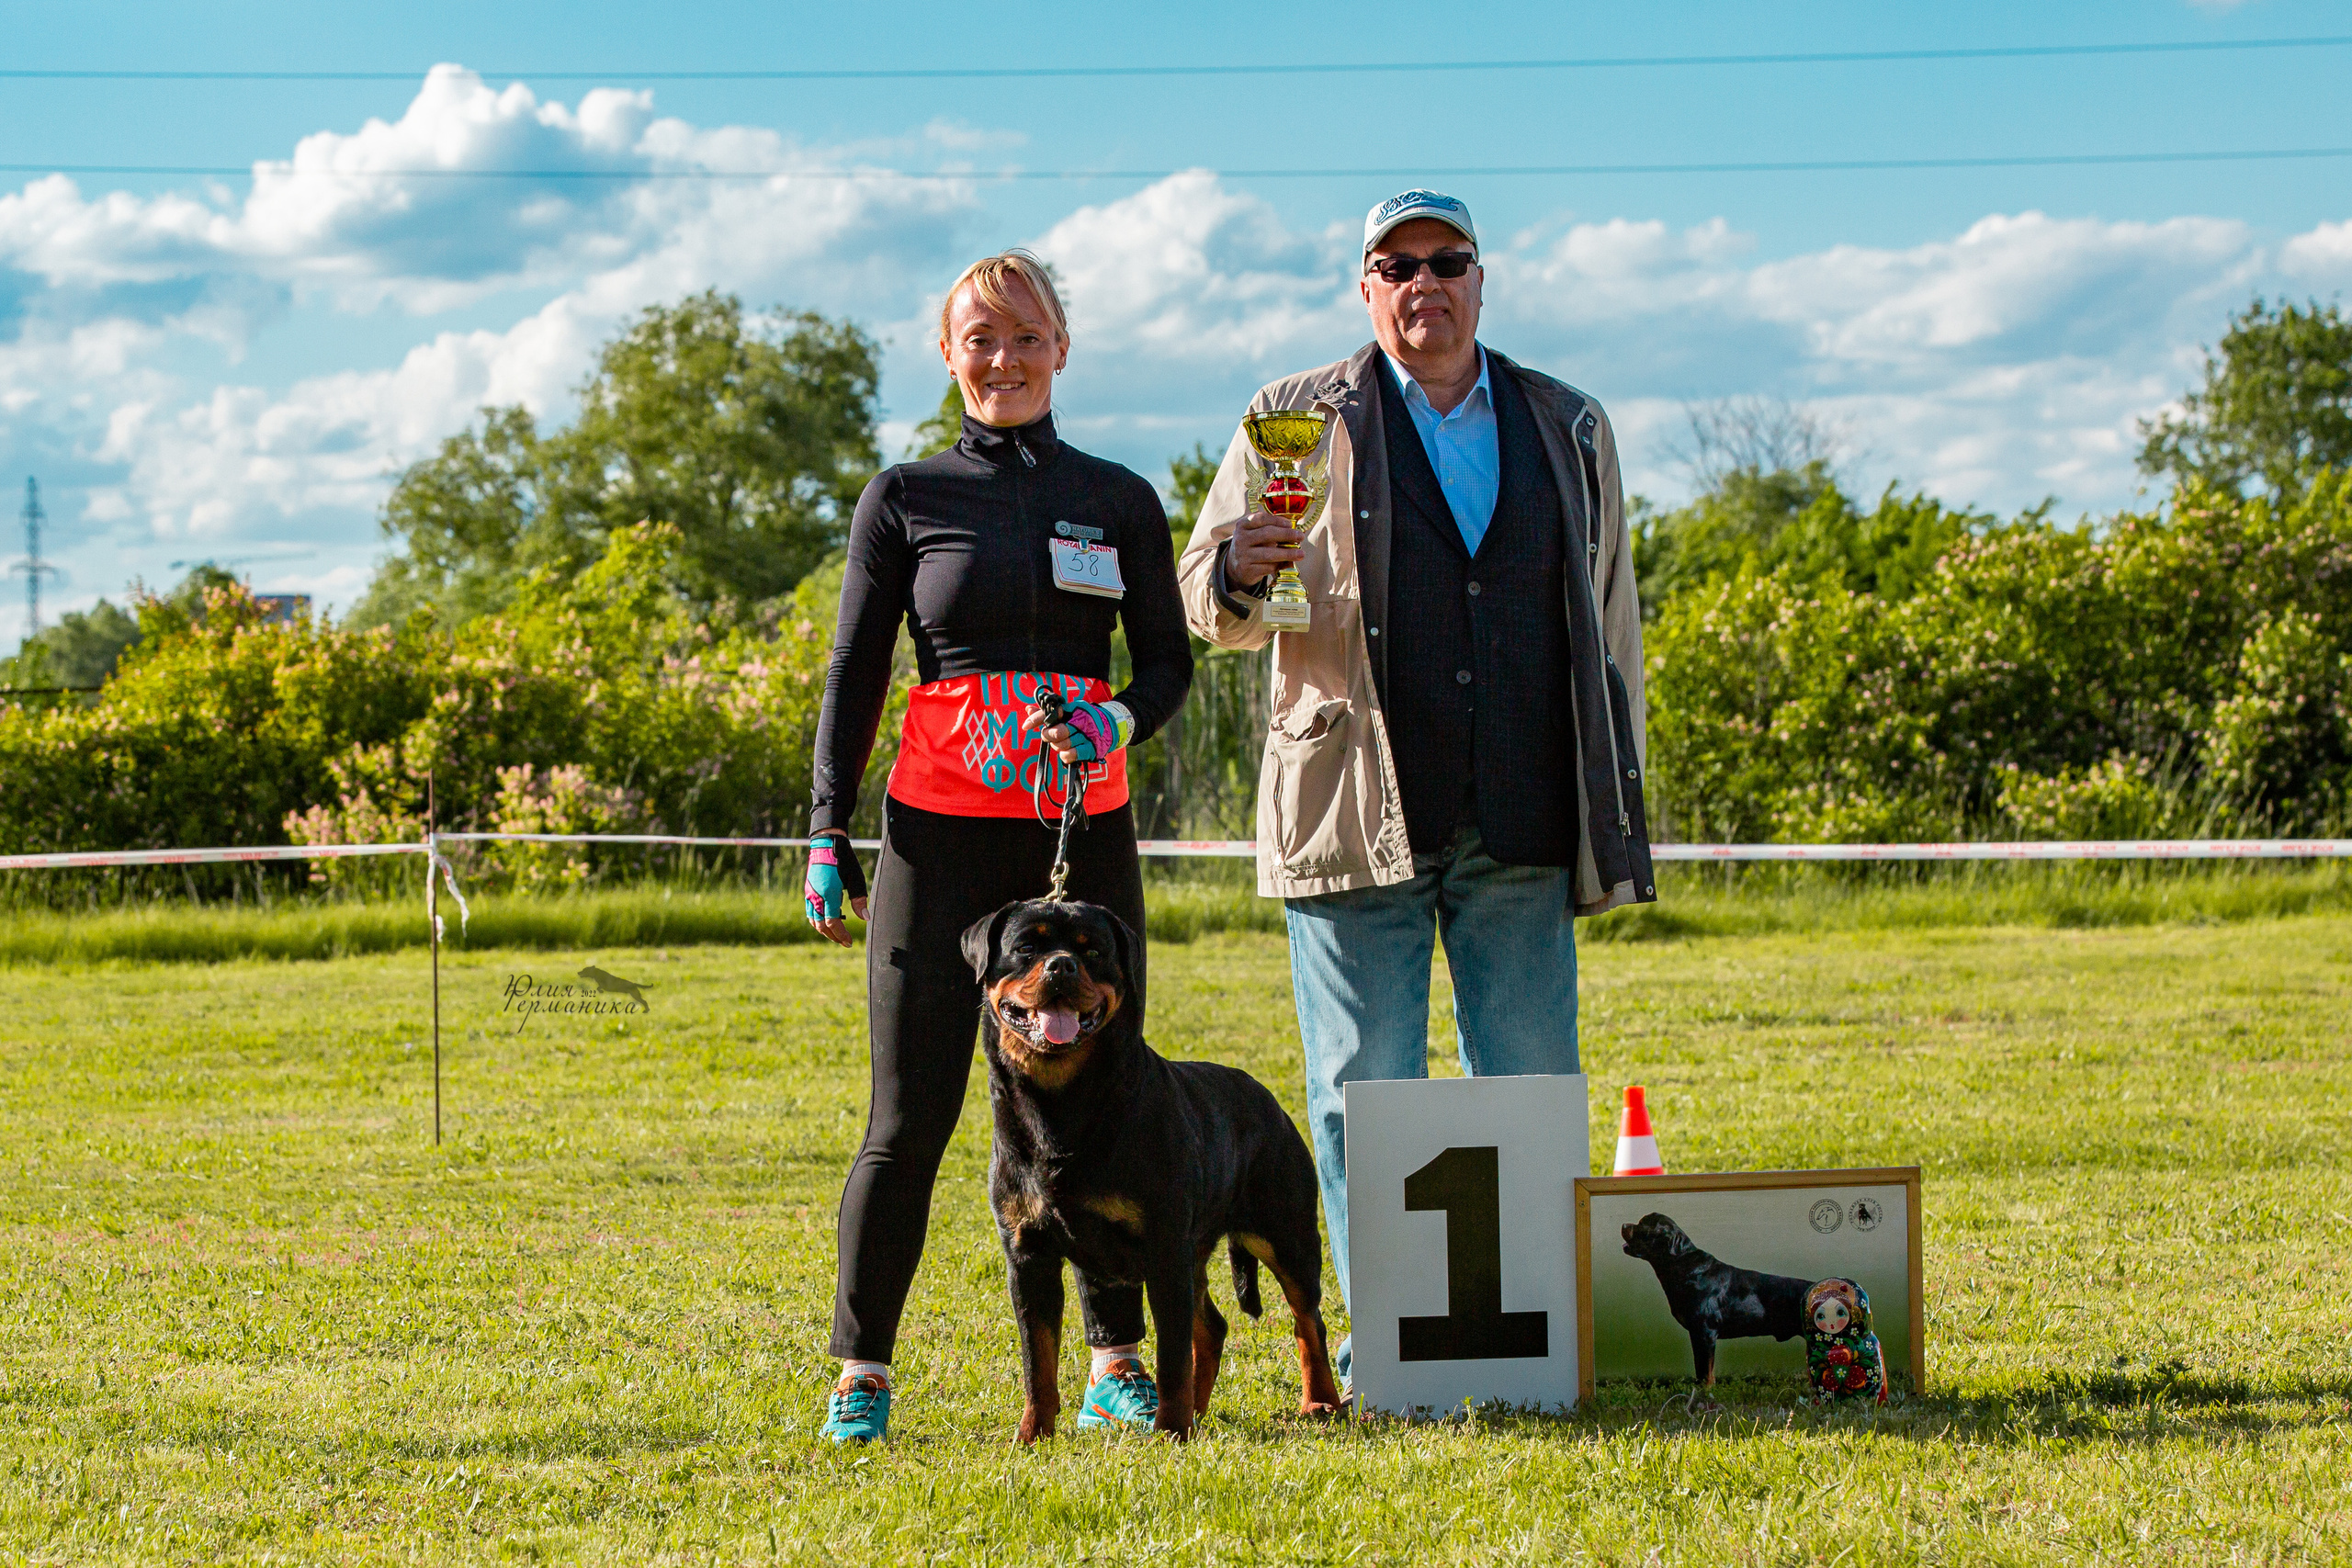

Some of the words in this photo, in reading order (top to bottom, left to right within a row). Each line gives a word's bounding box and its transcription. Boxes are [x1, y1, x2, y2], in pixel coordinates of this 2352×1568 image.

[1090, 544, 1112, 553] ANIN
[1068, 552, 1099, 577] 58
[1398, 1145, 1549, 1362] 1
